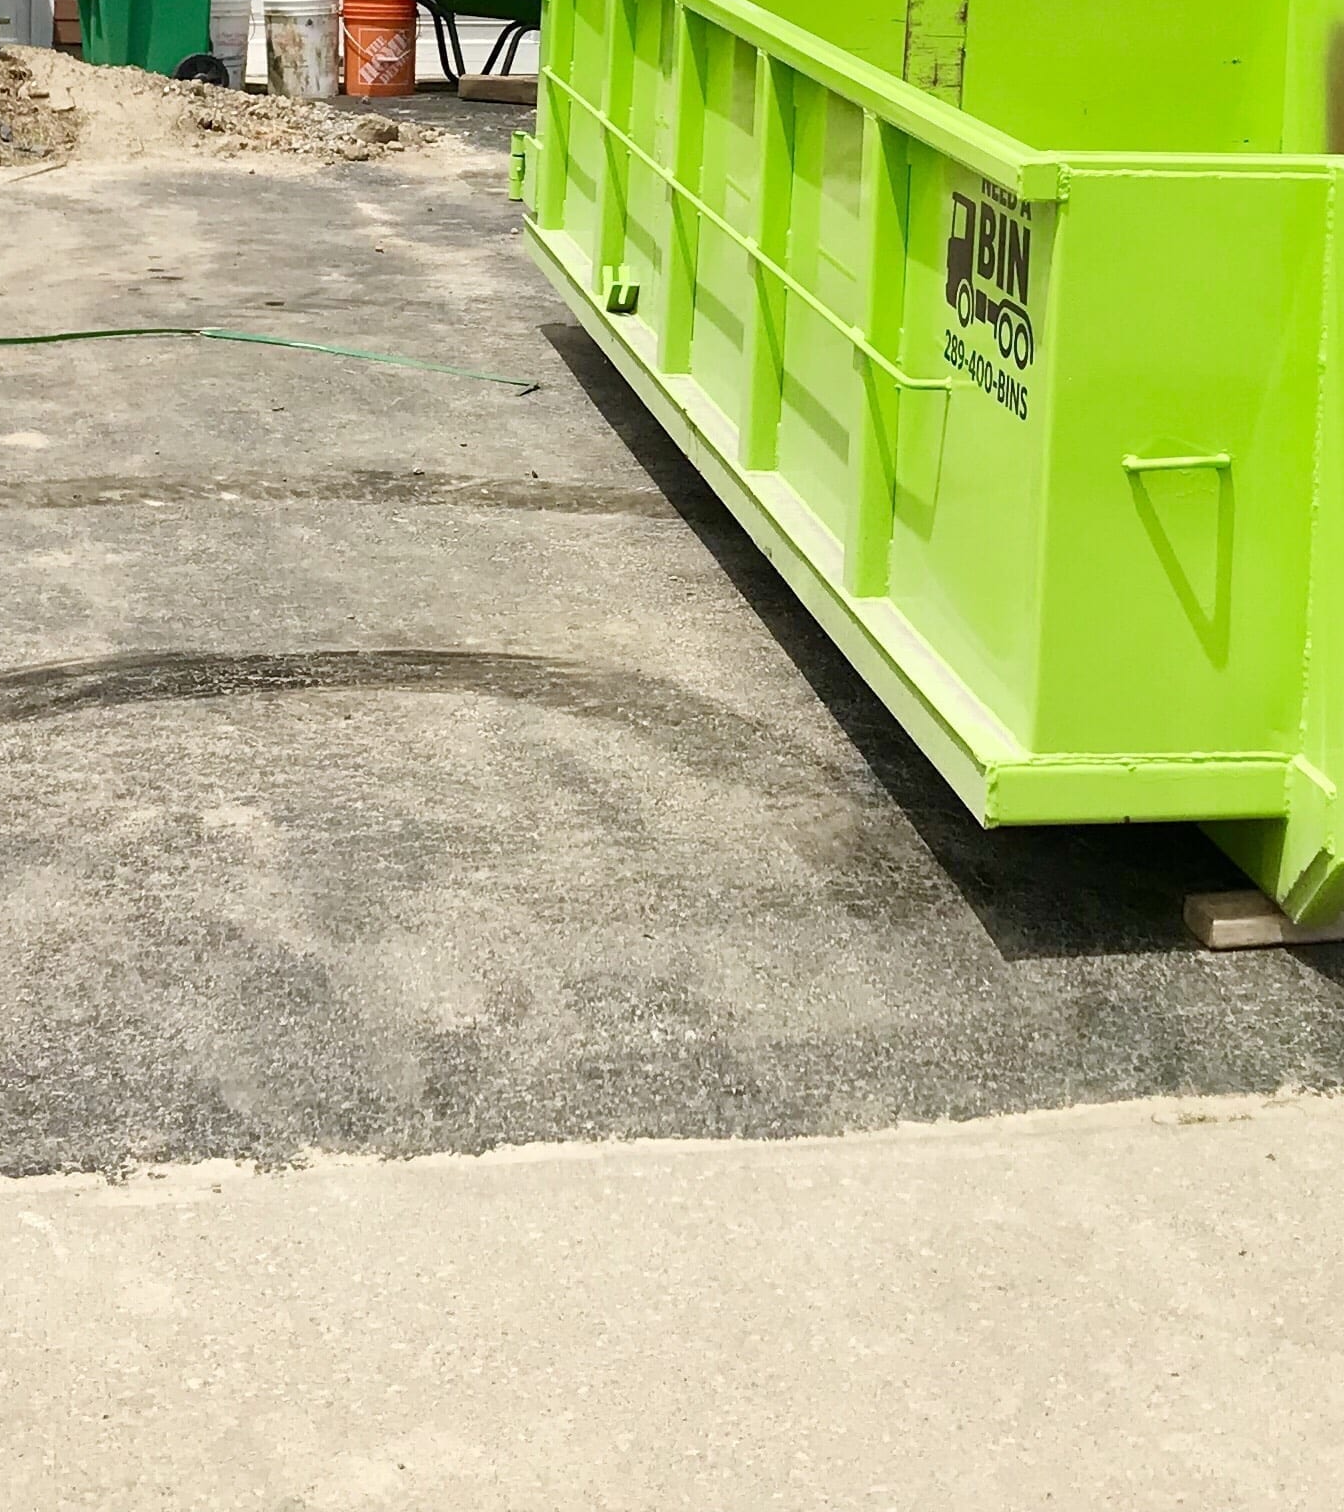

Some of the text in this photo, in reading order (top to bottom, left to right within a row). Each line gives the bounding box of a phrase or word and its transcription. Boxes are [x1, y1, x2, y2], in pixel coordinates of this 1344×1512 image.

[365, 35, 385, 57] THE
[977, 200, 1031, 306] BIN
[944, 329, 1028, 421] 289-400-BINS
